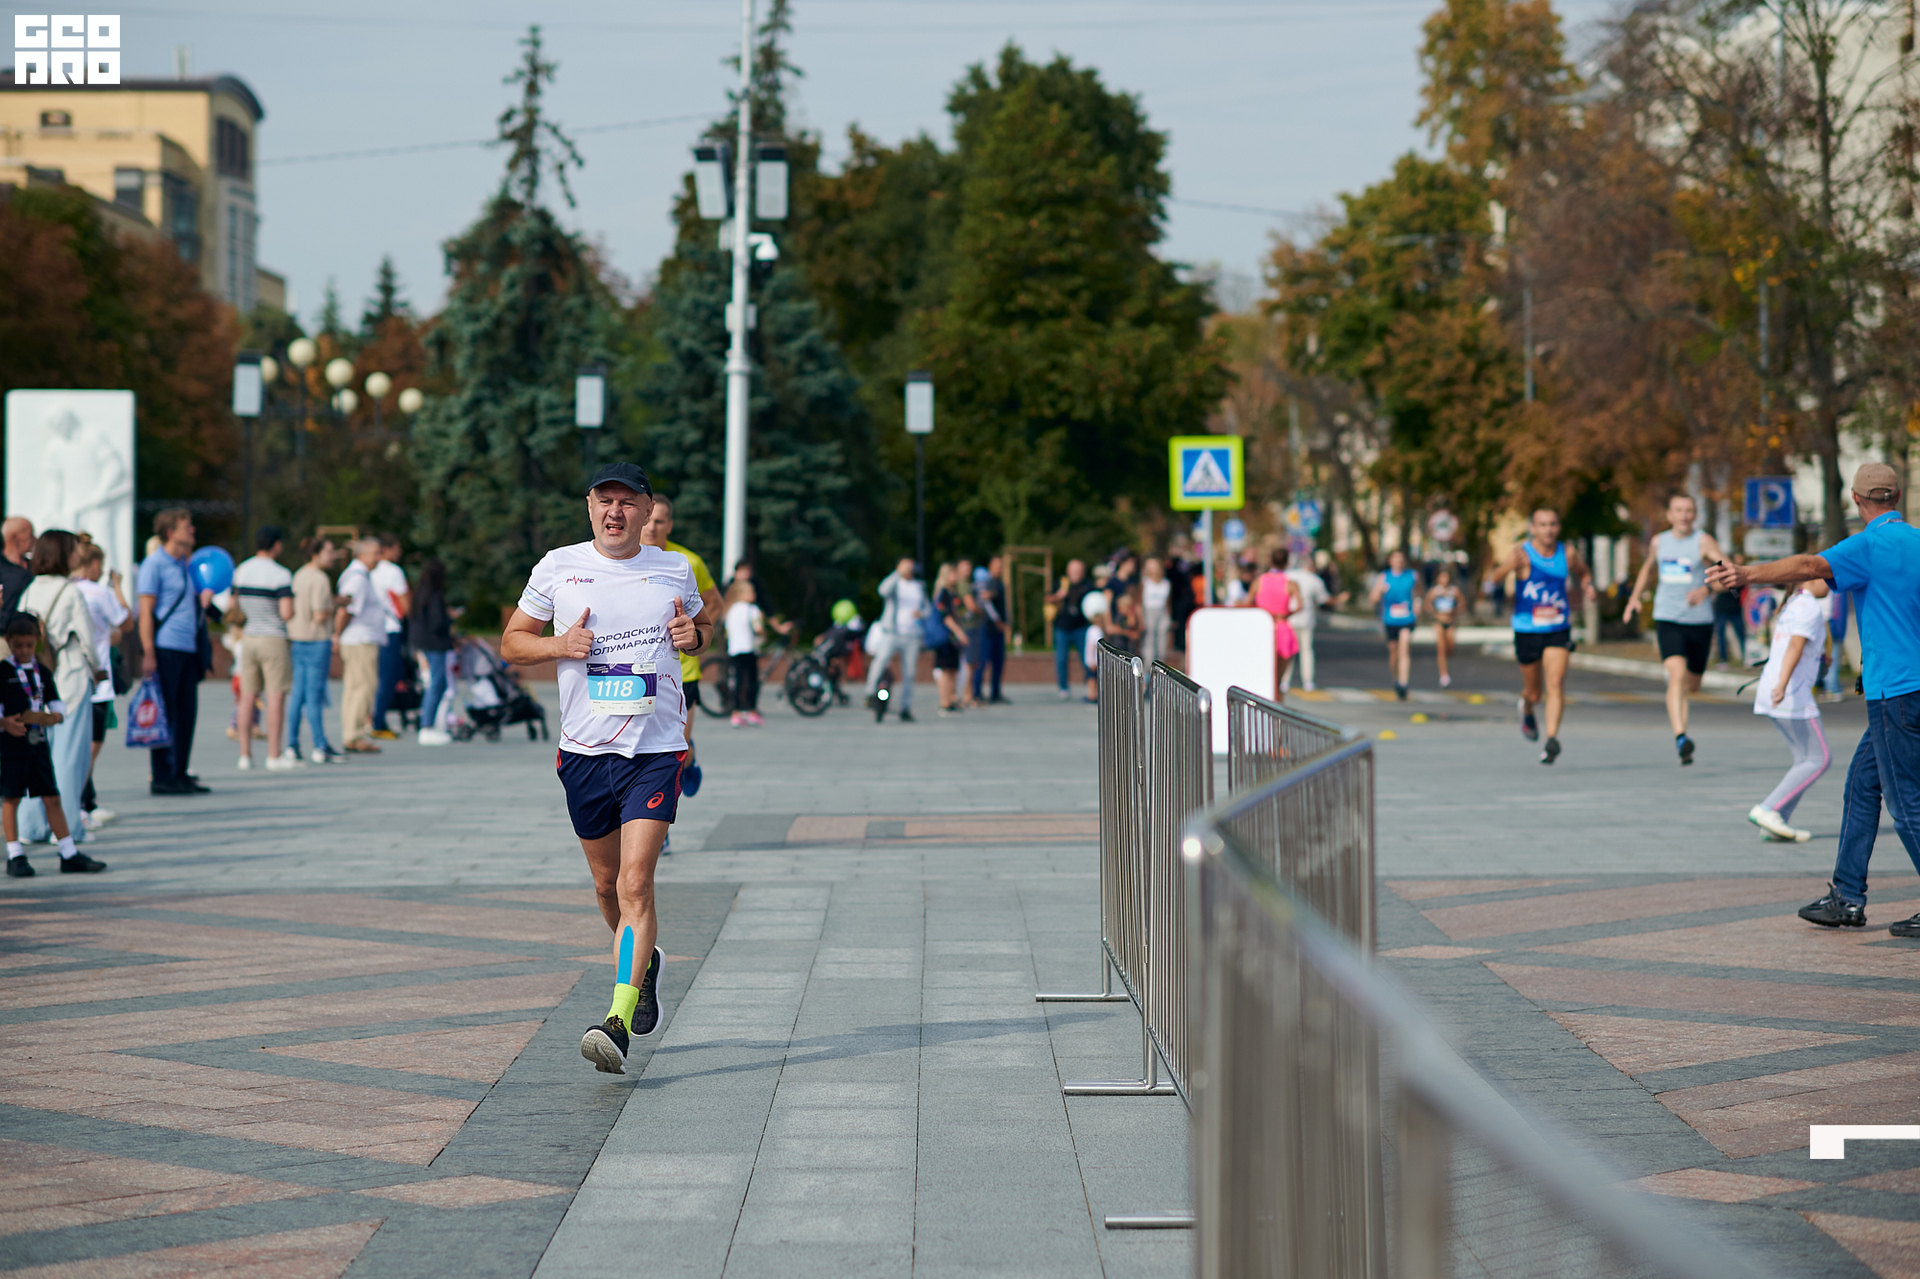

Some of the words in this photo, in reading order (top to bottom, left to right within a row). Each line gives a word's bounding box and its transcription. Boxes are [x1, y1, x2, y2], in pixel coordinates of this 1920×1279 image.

[1759, 483, 1786, 521] P
[634, 646, 667, 662] 2021
[597, 680, 634, 697] 1118
